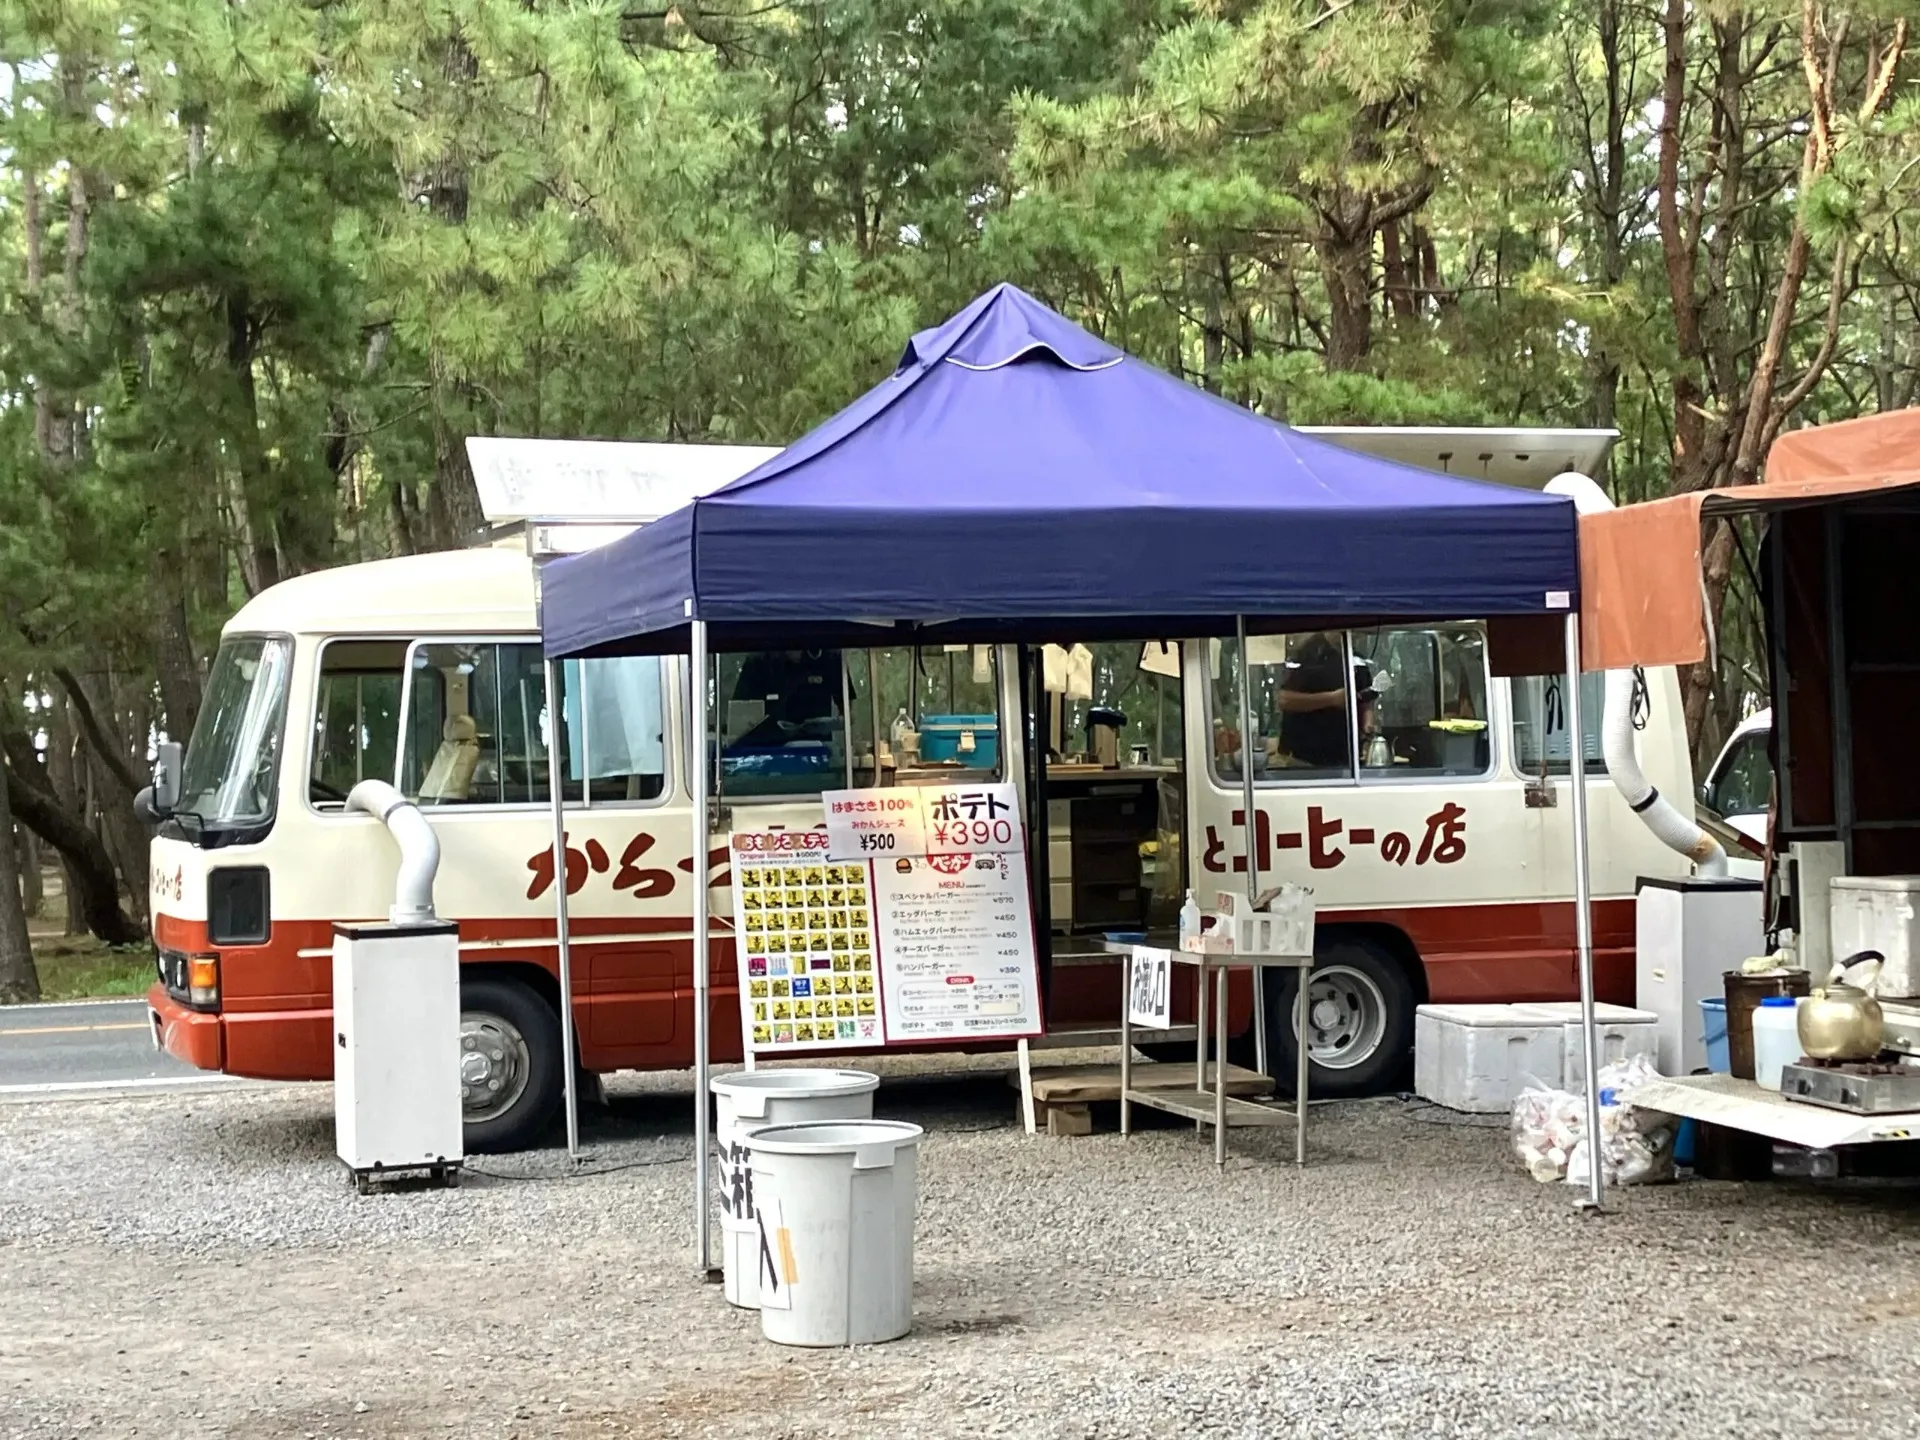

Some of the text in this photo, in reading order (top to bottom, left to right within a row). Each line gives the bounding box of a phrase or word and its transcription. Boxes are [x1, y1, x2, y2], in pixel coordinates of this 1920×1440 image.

[831, 798, 914, 814] はまさき100%
[930, 792, 1010, 821] ポテト
[851, 819, 906, 830] みかんジュース
[933, 820, 1012, 846] ¥390
[859, 832, 896, 851] ¥500
[1203, 802, 1467, 873] とコーヒーの店
[938, 881, 965, 889] MENU
